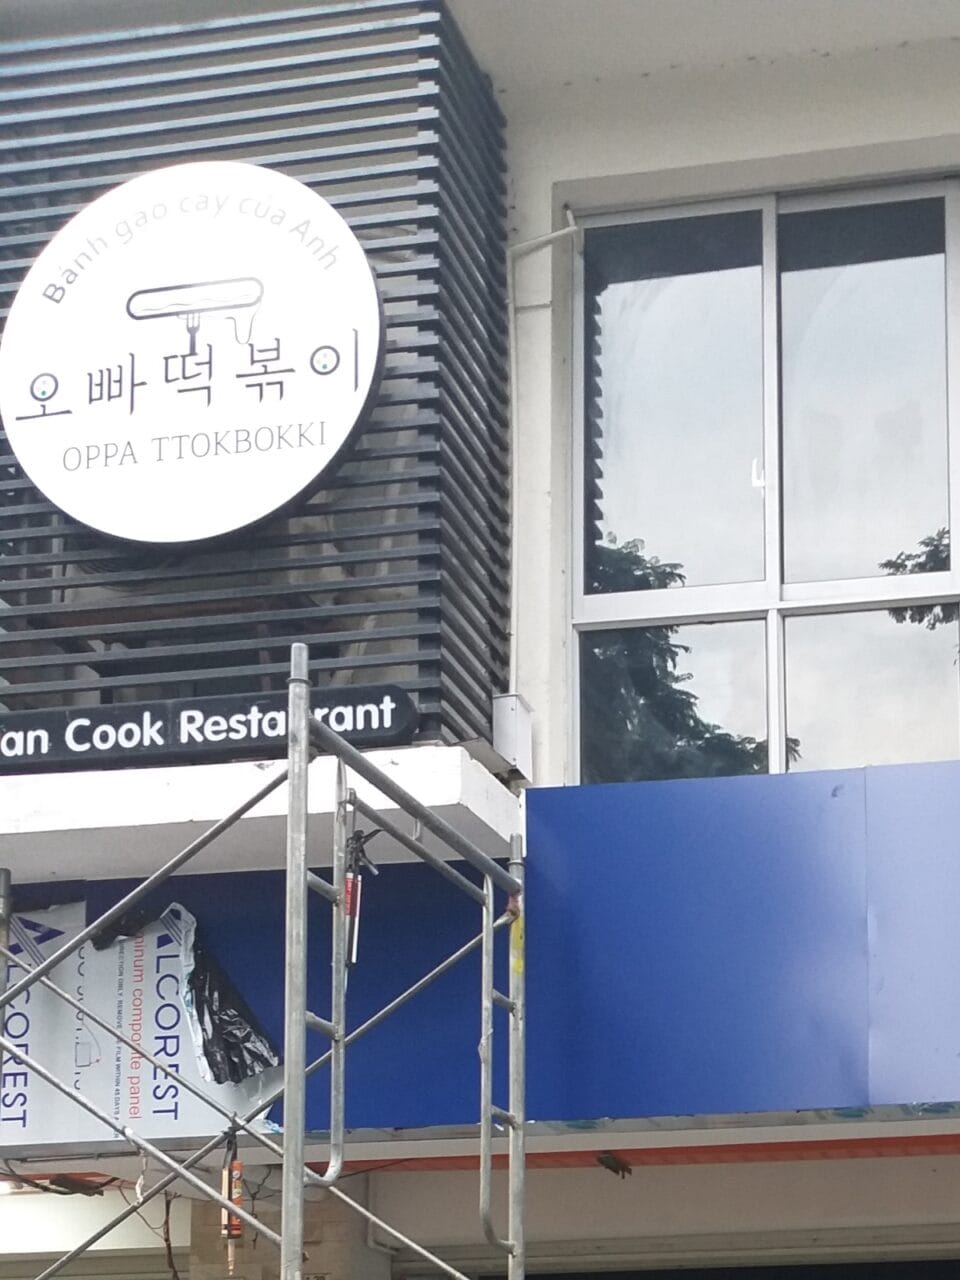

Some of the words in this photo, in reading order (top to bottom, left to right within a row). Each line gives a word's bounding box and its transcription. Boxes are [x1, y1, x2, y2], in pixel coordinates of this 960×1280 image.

[42, 236, 109, 305] Bánh
[179, 195, 230, 218] cay
[288, 219, 340, 271] Anh
[62, 440, 139, 472] OPPA
[152, 420, 327, 463] TTOKBOKKI
[64, 710, 165, 751] Cook
[180, 695, 396, 741] Restarant
[127, 1076, 142, 1120] panel
